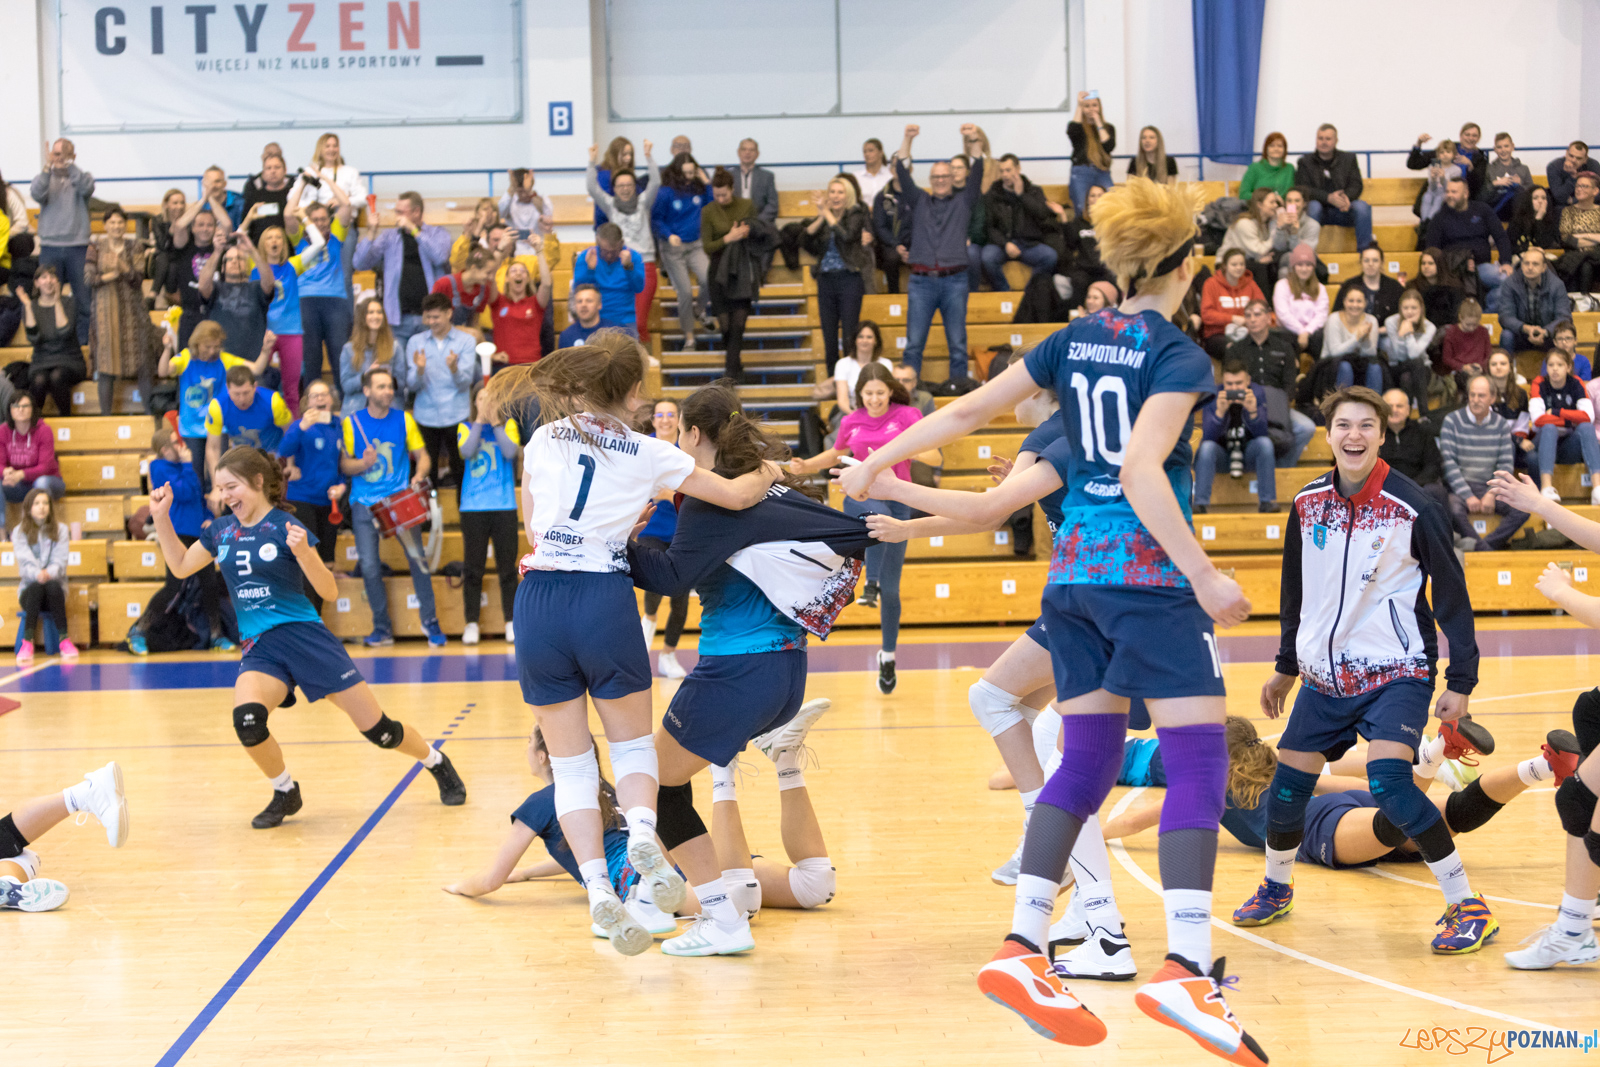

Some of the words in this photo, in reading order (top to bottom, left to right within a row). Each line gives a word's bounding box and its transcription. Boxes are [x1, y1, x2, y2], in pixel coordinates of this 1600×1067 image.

[94, 1, 420, 55] CITYZEN
[196, 57, 249, 72] WIĘCEJ
[290, 56, 330, 69] KLUB
[338, 55, 422, 69] SPORTOWY
[553, 106, 569, 131] B
[1070, 372, 1132, 467] 10
[551, 426, 639, 457] SZAMOTULANIN
[568, 453, 597, 521] 1
[543, 530, 584, 545] AGROBEX
[235, 550, 253, 576] 3
